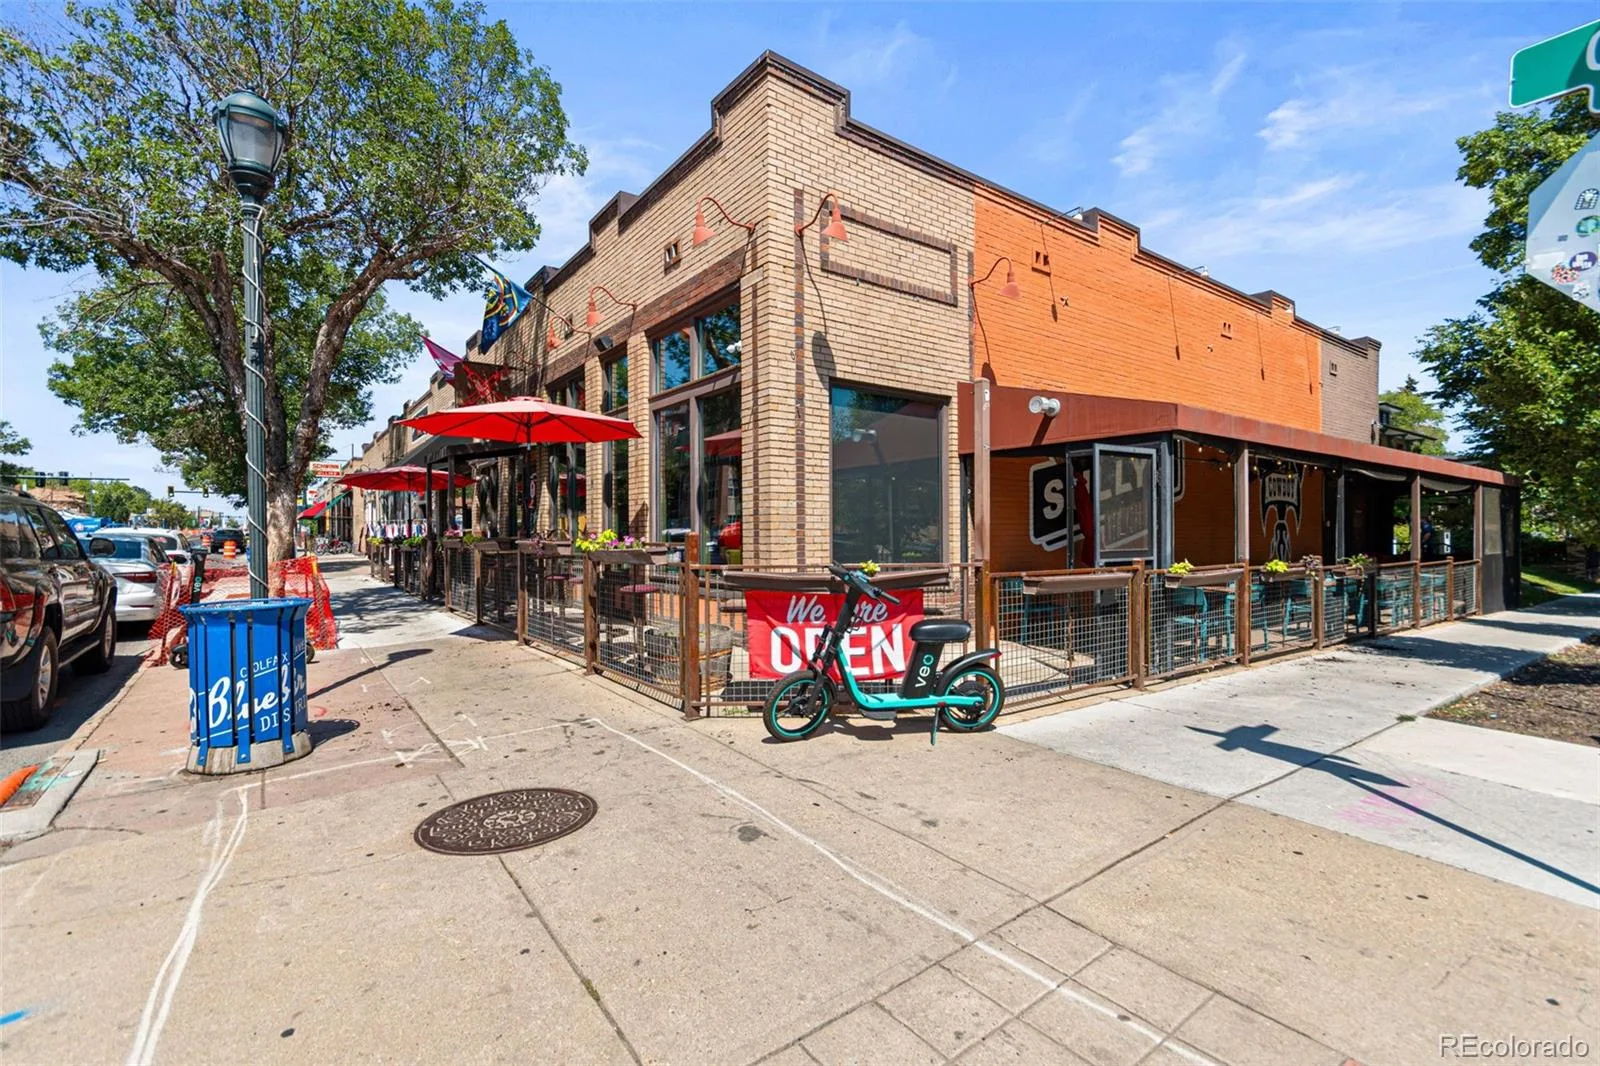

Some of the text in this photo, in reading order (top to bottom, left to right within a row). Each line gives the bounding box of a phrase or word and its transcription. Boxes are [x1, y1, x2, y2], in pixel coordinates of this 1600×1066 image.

[193, 576, 202, 593] veo
[787, 595, 827, 624] We
[240, 652, 288, 678] COLFAX
[915, 654, 934, 688] veo
